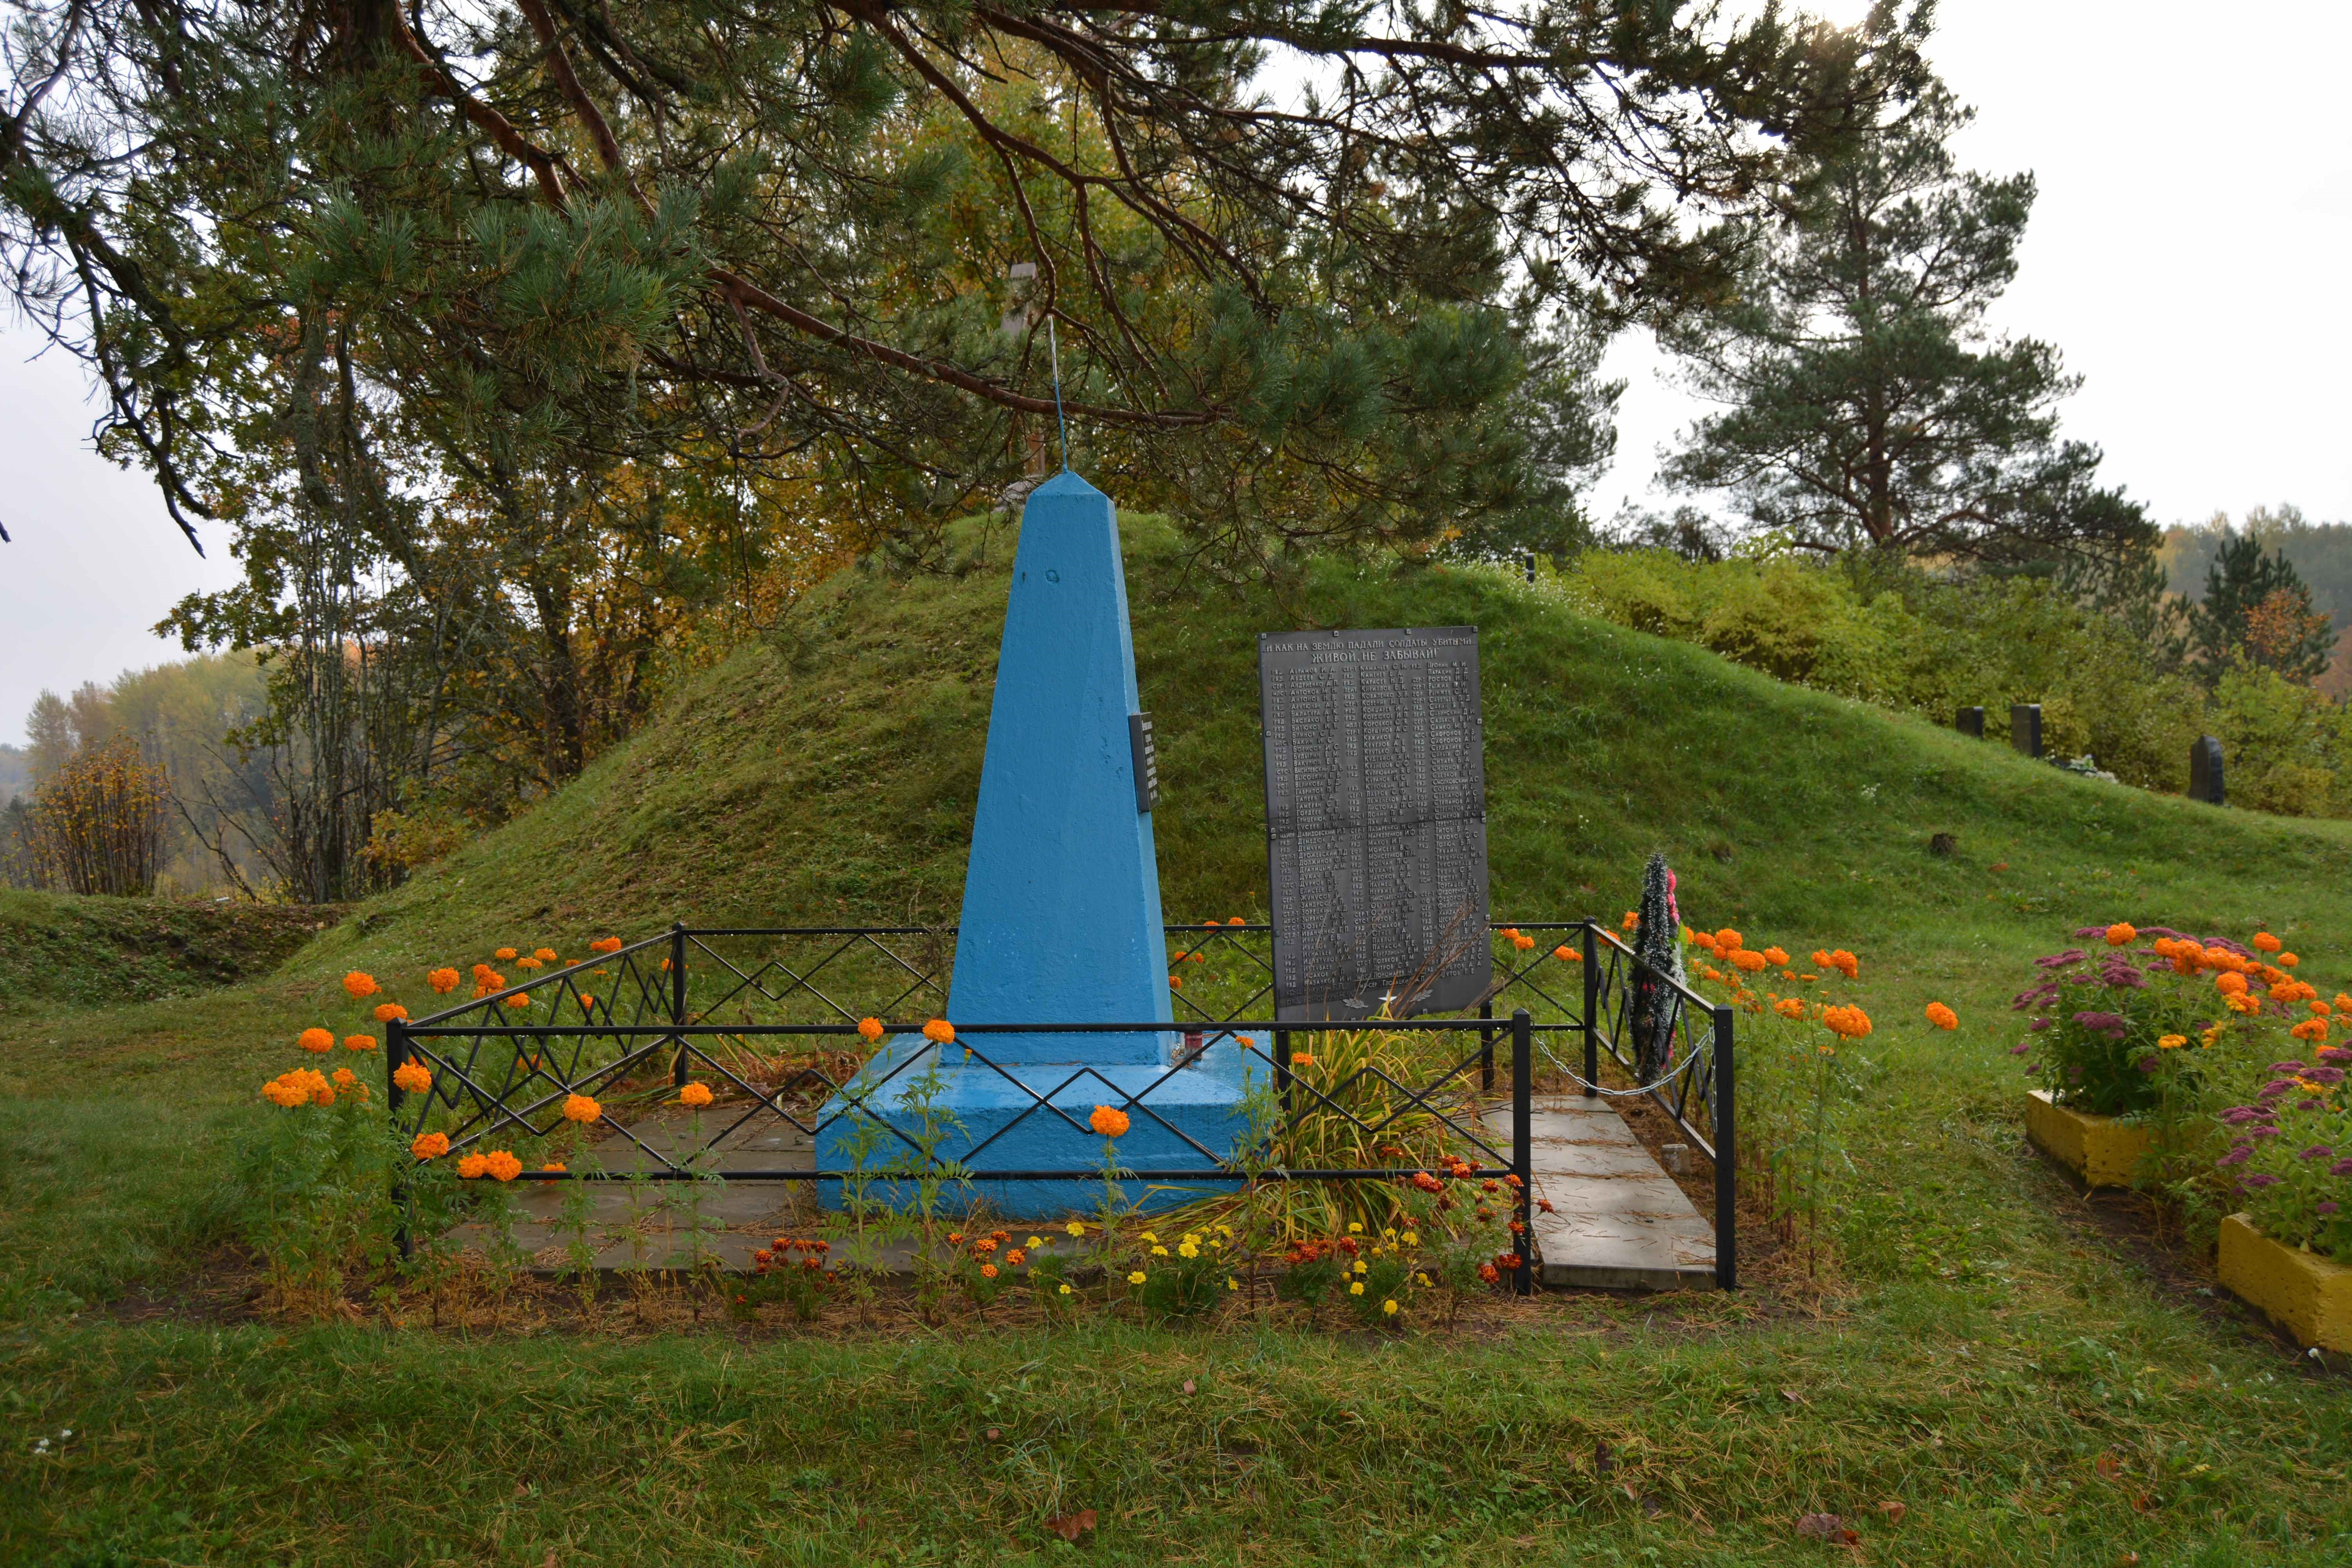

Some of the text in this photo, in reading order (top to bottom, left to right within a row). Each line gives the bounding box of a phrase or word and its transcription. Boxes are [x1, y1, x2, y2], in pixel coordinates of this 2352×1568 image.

[1348, 641, 1383, 650] ПАДАЛИ
[1389, 639, 1427, 648] СОЛДАТЫ
[1361, 652, 1377, 661] НЕ
